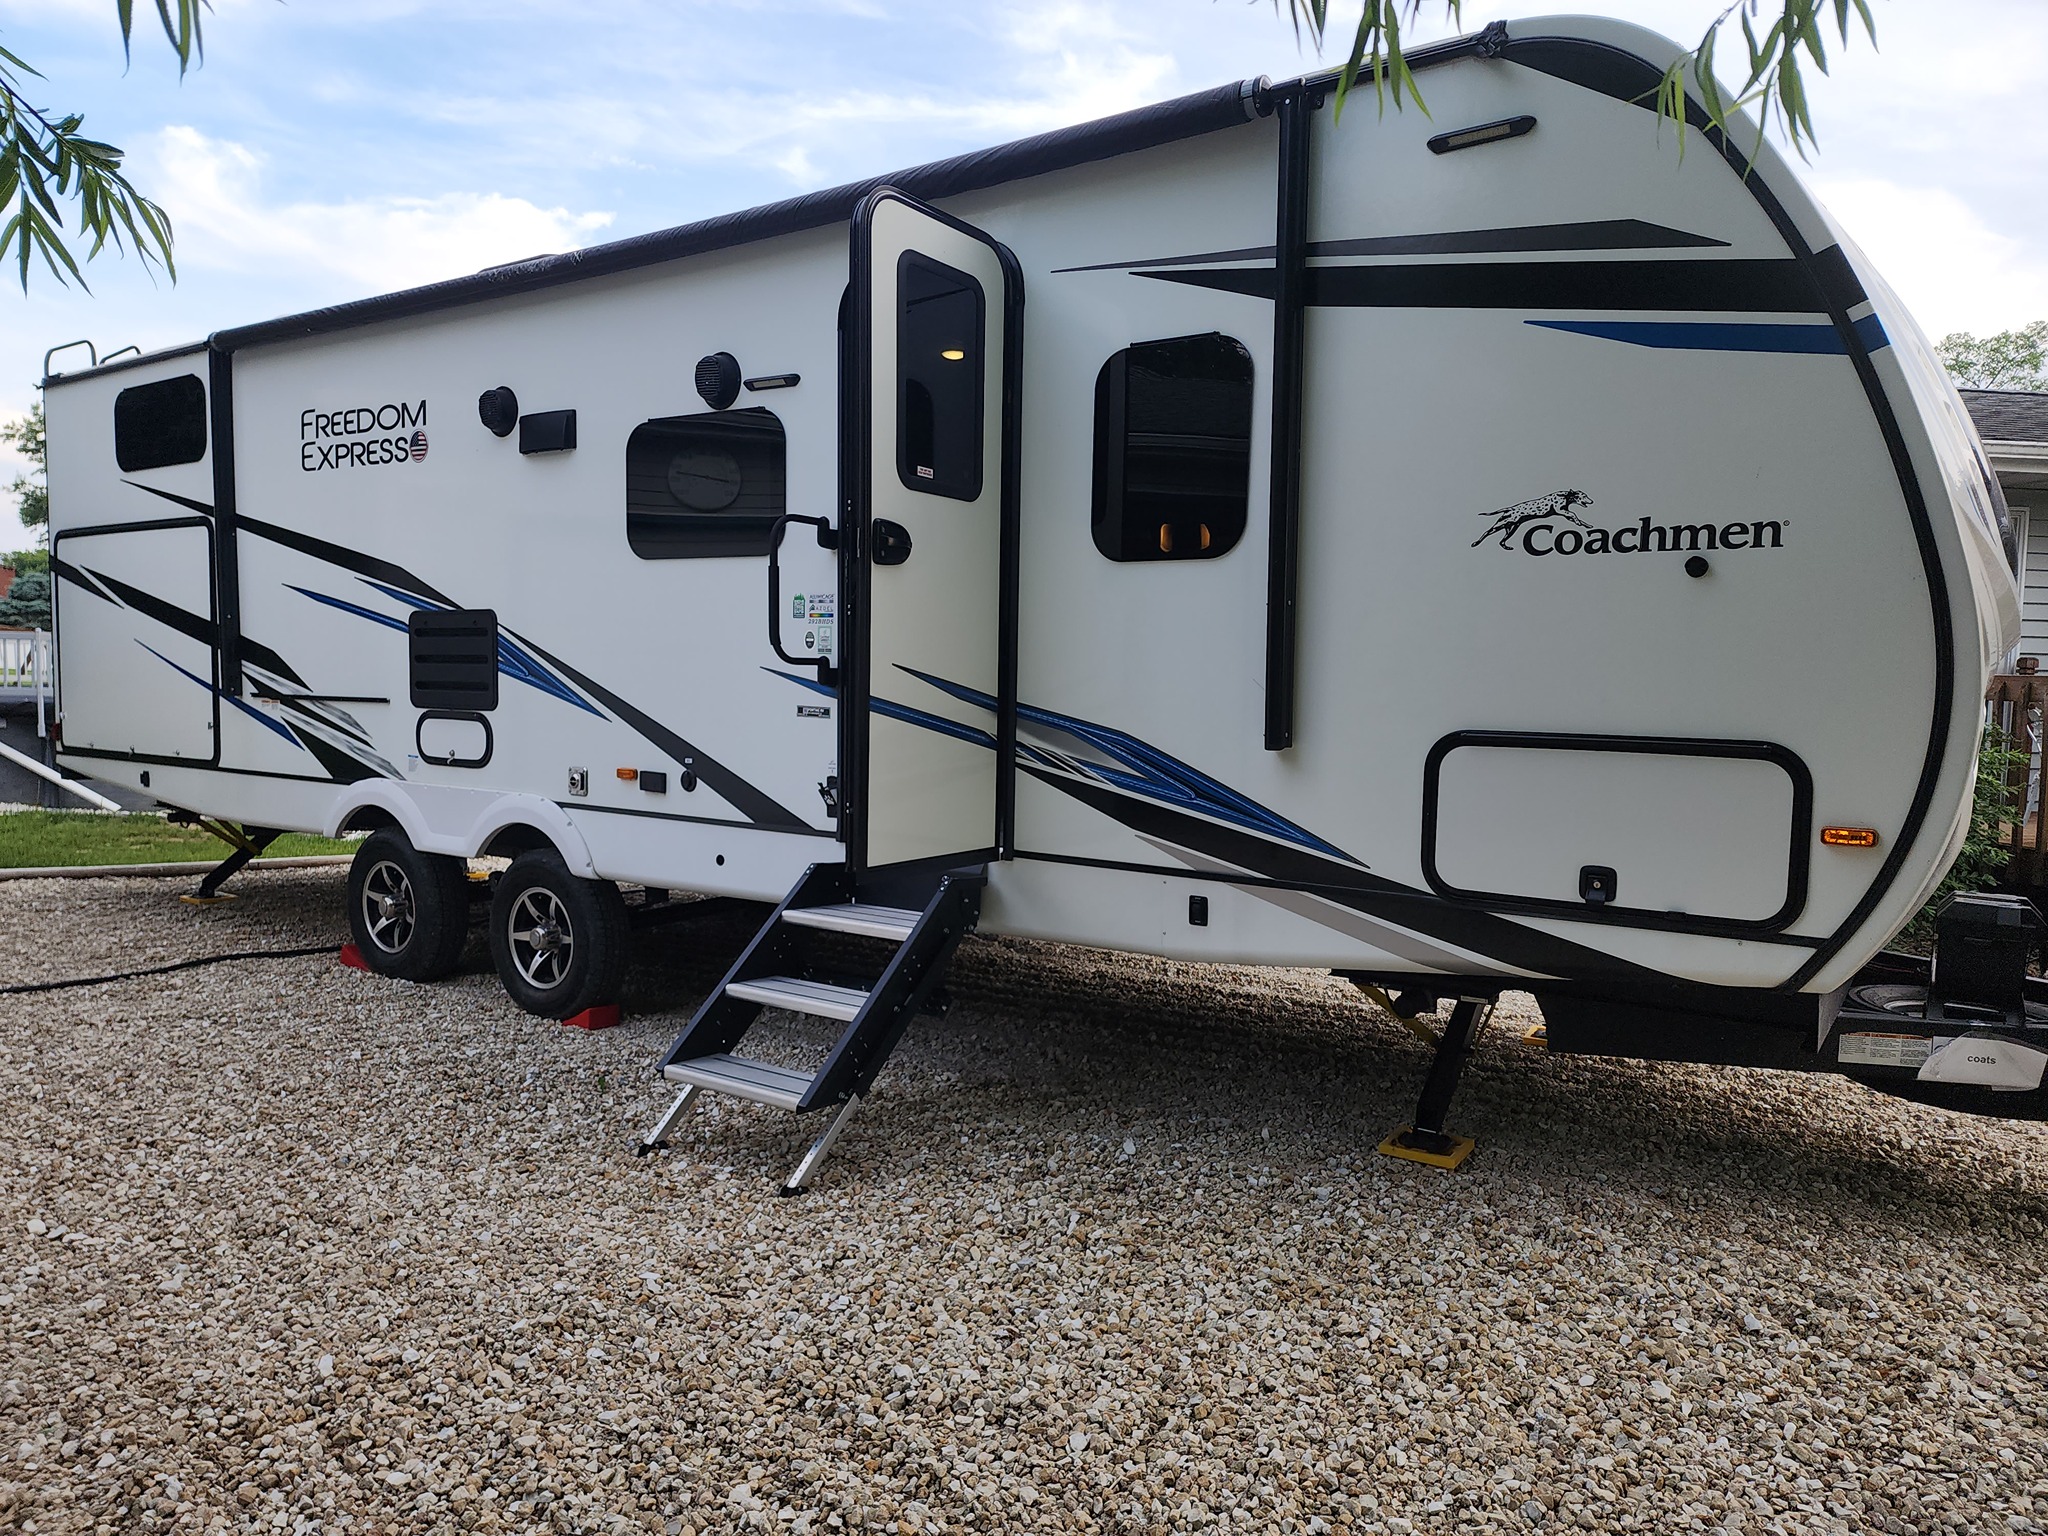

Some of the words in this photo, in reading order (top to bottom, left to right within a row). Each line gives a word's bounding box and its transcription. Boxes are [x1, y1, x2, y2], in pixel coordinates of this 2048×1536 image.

[301, 400, 427, 440] FREEDOM
[301, 436, 409, 472] EXPRESS
[1522, 516, 1784, 557] Coachmen
[1967, 1054, 1997, 1065] coats
